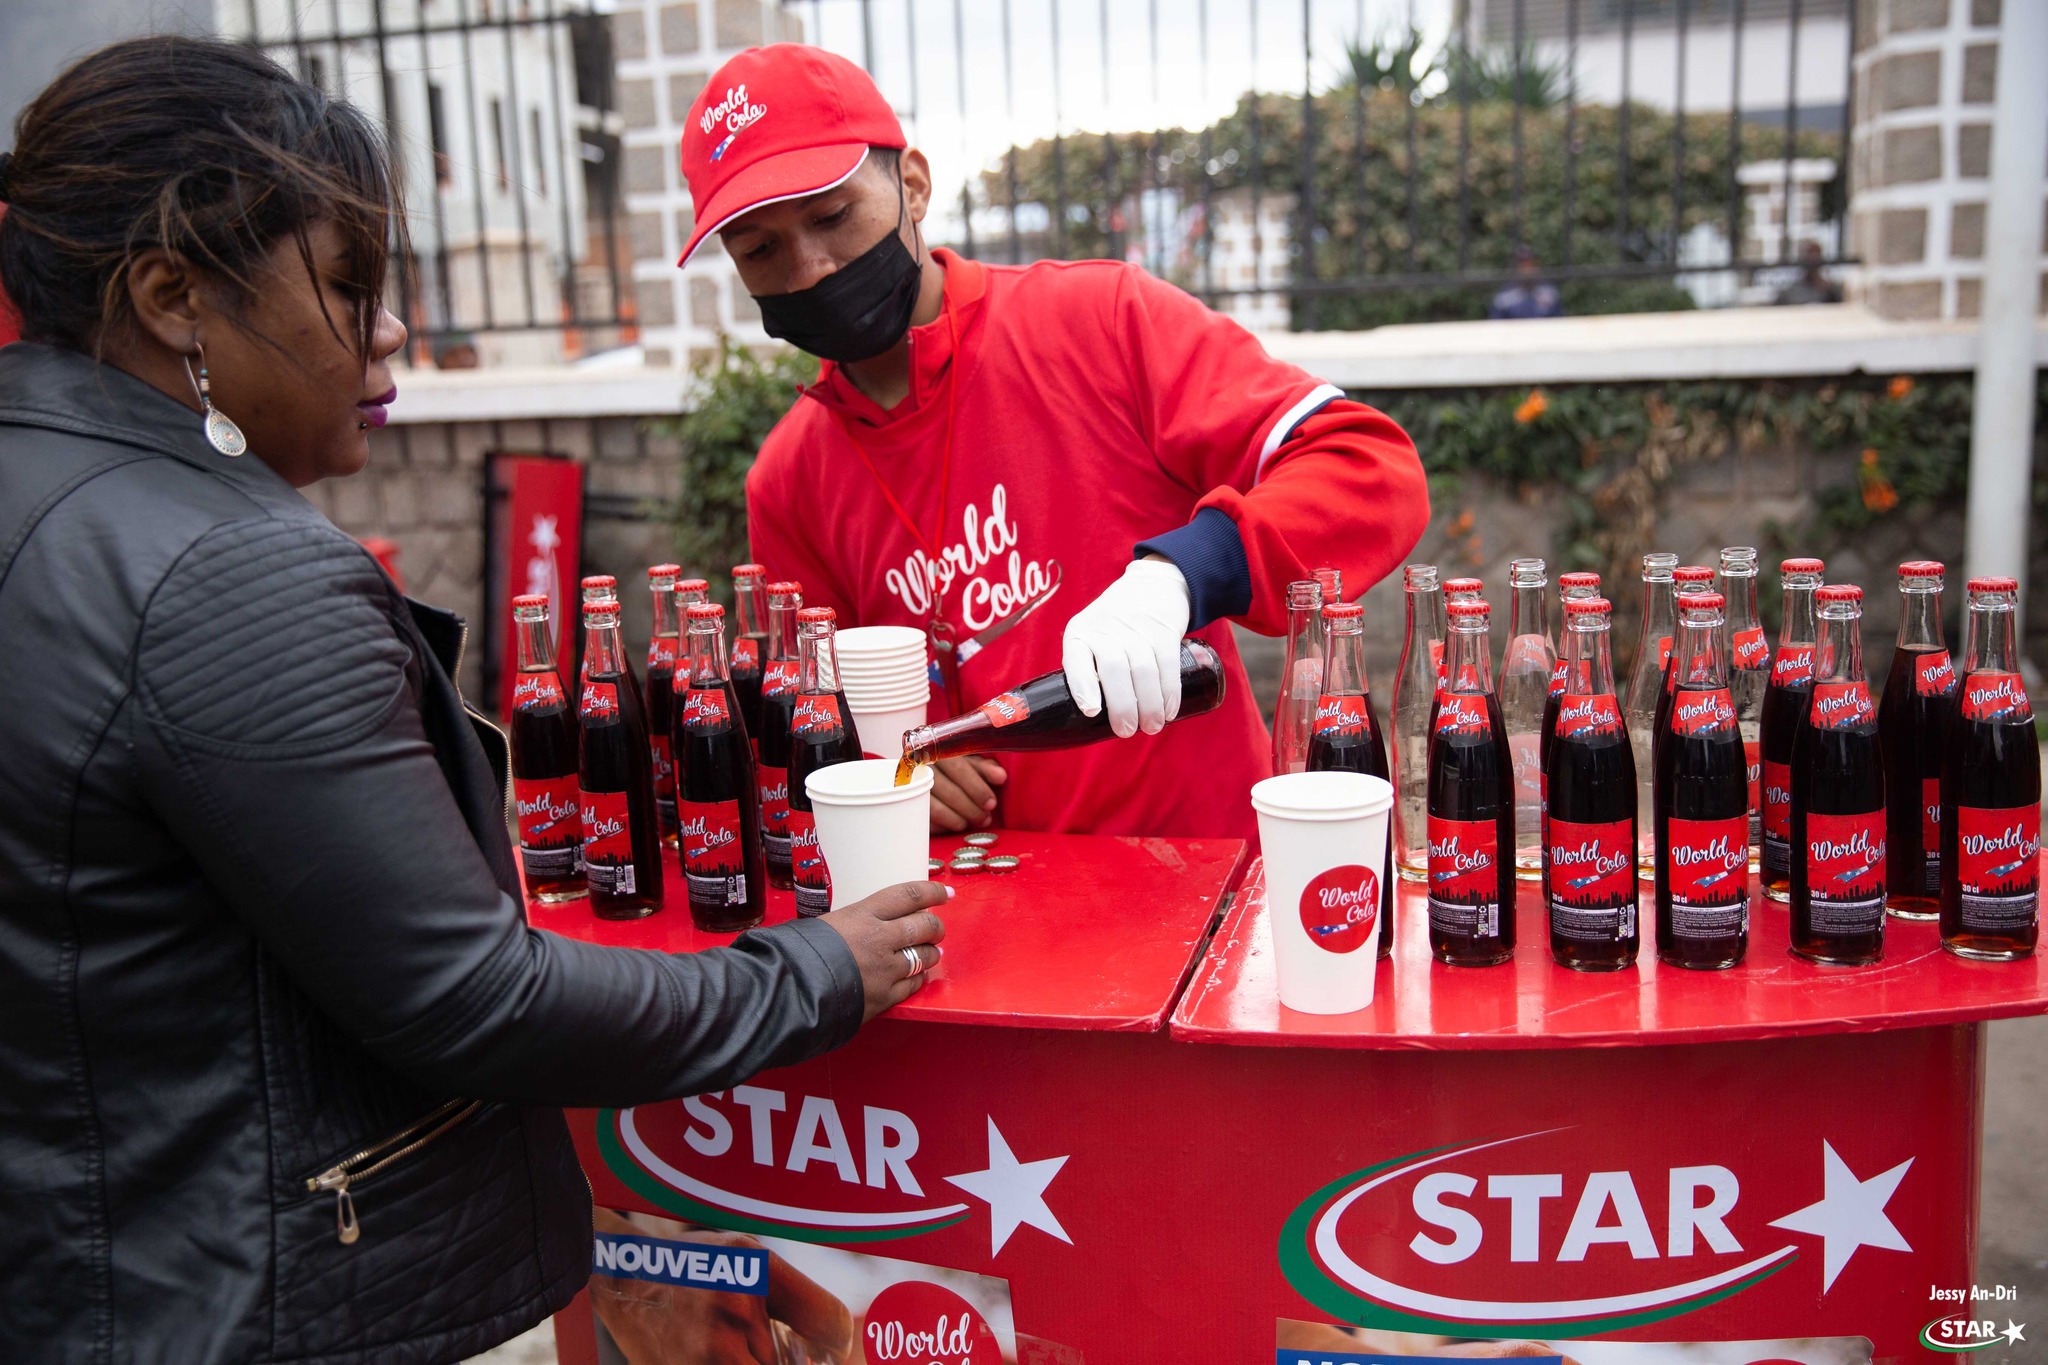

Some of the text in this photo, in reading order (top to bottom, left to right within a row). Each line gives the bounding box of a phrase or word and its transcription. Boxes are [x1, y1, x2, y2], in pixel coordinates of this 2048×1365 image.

[700, 84, 749, 135] World
[726, 102, 763, 132] Cola
[885, 483, 1018, 615] World
[962, 550, 1054, 631] Cola
[1776, 652, 1811, 674] World
[536, 686, 557, 698] Cola
[591, 696, 610, 708] Cola
[684, 694, 703, 712] orld
[1817, 688, 1858, 715] World
[1970, 679, 2013, 706] World
[2011, 688, 2028, 706] Cola
[699, 703, 721, 716] Cola
[811, 709, 832, 722] Cola
[1560, 699, 1594, 723] World
[1678, 695, 1717, 721] World
[1715, 704, 1734, 720] Cola
[1856, 695, 1873, 714] Cola
[1337, 710, 1362, 726] Cola
[1456, 710, 1481, 724] Cola
[1590, 709, 1615, 725] Cola
[550, 800, 577, 820] Cola
[594, 818, 621, 836] Cola
[704, 827, 733, 847] Cola
[1811, 829, 1869, 862] World
[1963, 823, 2023, 855] World
[2019, 833, 2040, 859] Cola
[1455, 850, 1489, 870] Cola
[1551, 839, 1600, 866] World
[1672, 835, 1729, 867] World
[1724, 845, 1748, 869] Cola
[1866, 841, 1886, 864] Cola
[1926, 851, 1936, 859] 30
[1596, 854, 1627, 874] Cola
[1319, 875, 1375, 908] World
[1672, 894, 1688, 904] 30 cl
[1811, 890, 1820, 898] 30
[1962, 884, 1979, 894] 30 cl
[1346, 899, 1375, 923] Cola
[682, 1084, 926, 1198] STAR
[1408, 1165, 1748, 1265] STAR
[595, 1239, 761, 1287] NOUVEAU
[867, 1312, 973, 1360] World
